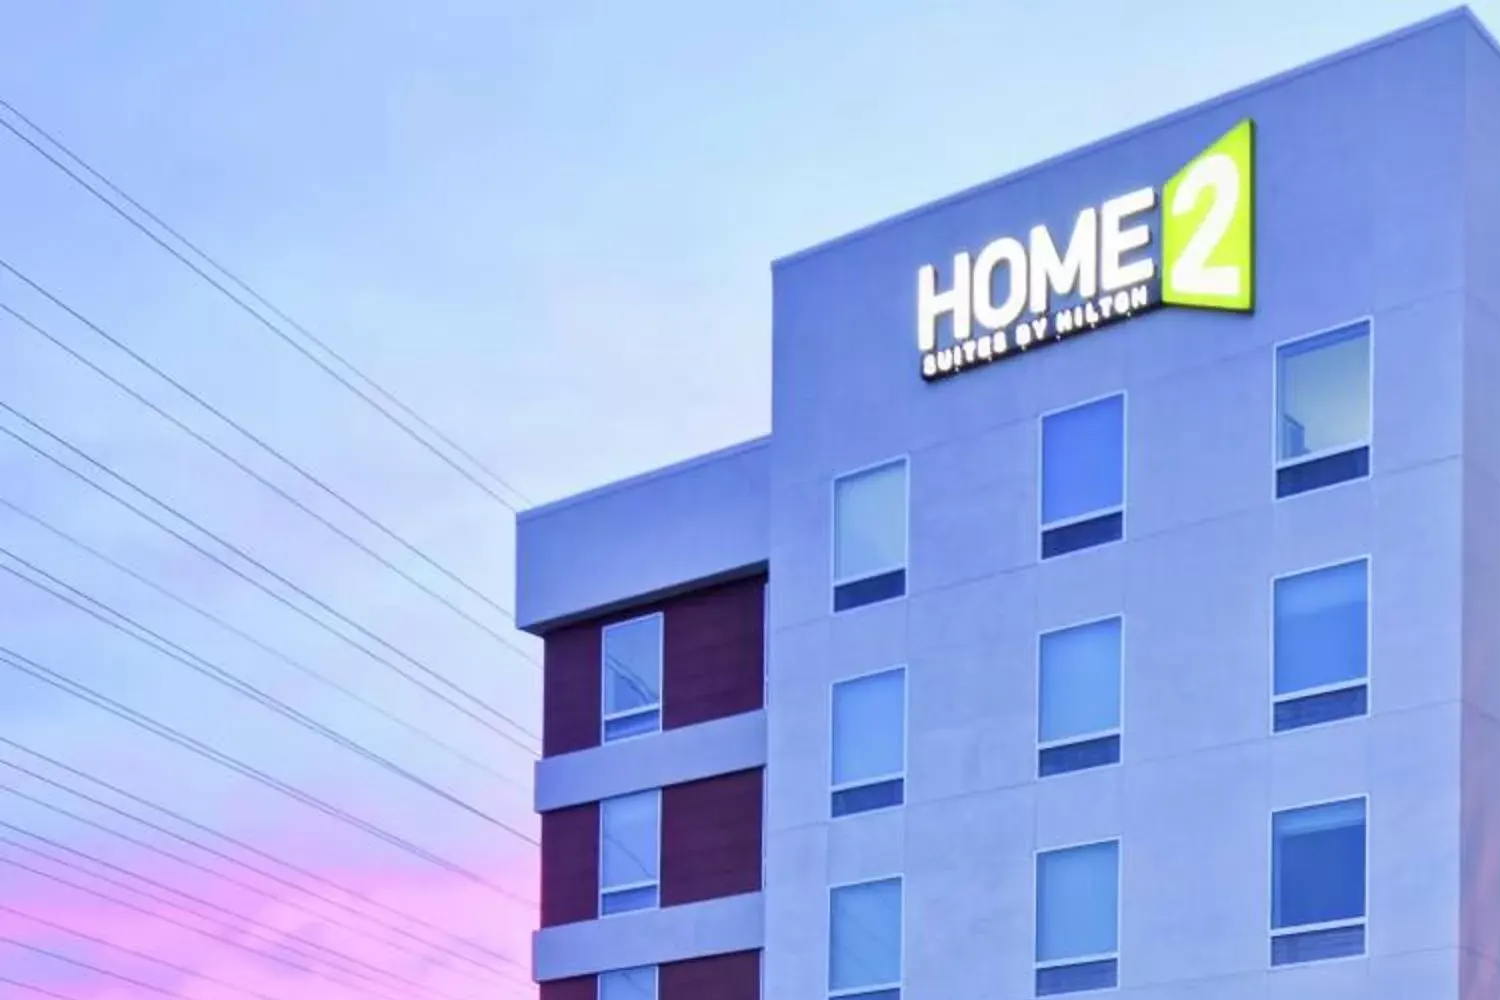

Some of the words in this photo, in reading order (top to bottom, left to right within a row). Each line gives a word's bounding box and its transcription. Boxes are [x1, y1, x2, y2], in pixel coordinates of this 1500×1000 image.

[918, 187, 1155, 352] HOME
[1171, 152, 1240, 298] 2
[923, 331, 1007, 376] SUITES
[1015, 317, 1048, 347] BY
[1056, 285, 1148, 334] HILTON
